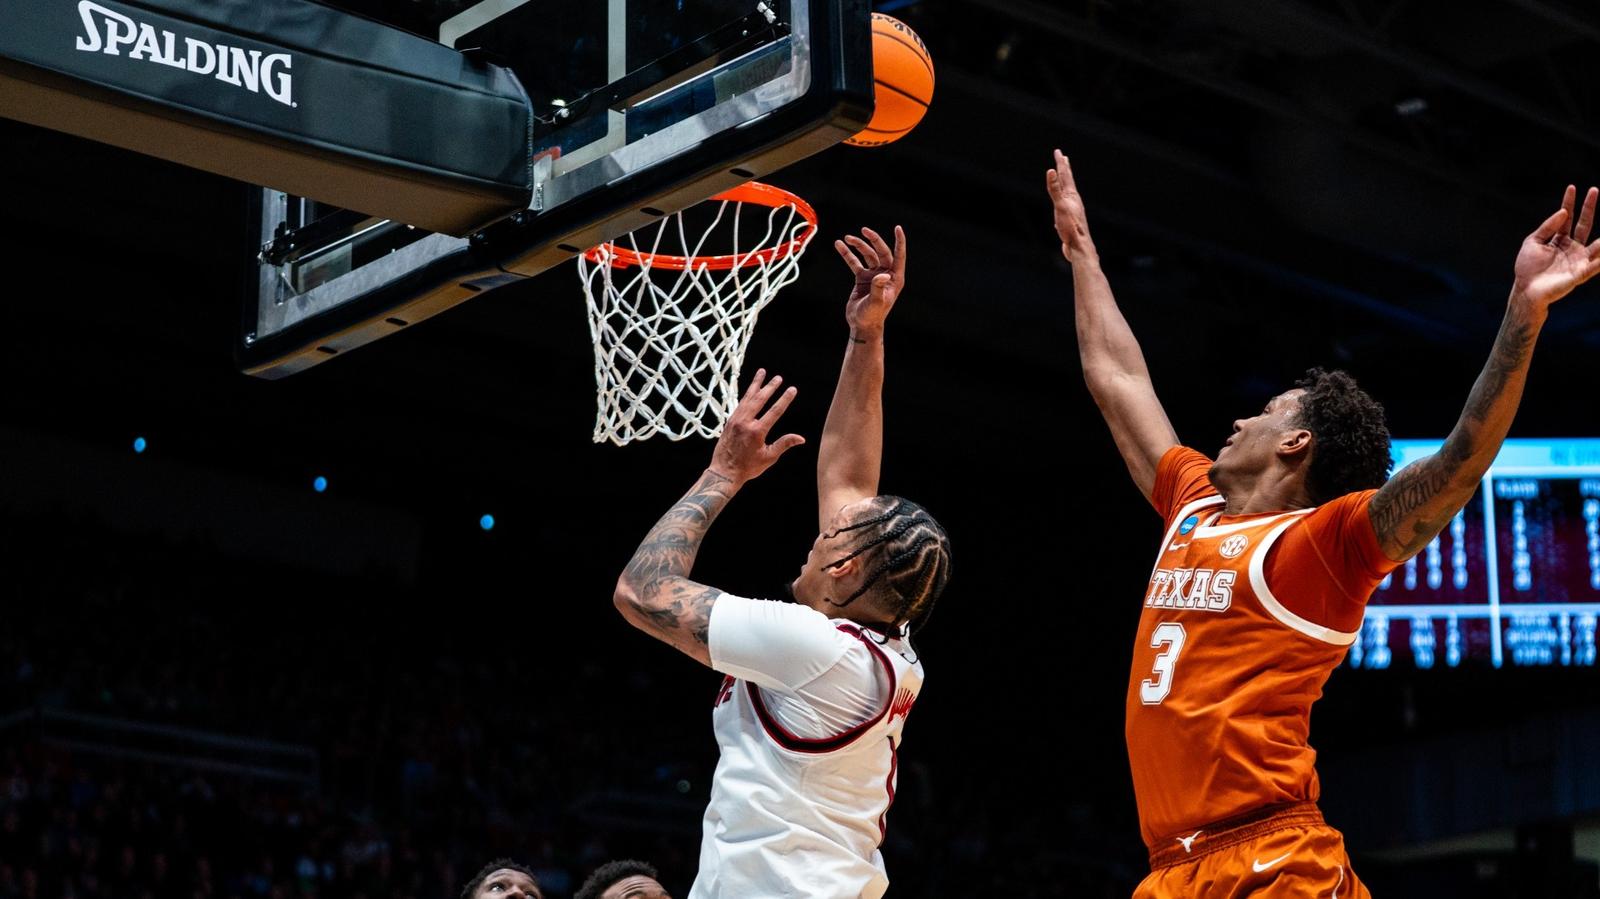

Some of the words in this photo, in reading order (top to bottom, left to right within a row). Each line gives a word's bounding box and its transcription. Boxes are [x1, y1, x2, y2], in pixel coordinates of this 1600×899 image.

[76, 0, 293, 107] SPALDING
[1221, 536, 1247, 557] SEC
[1145, 568, 1237, 612] TEXAS
[1139, 622, 1187, 706] 3
